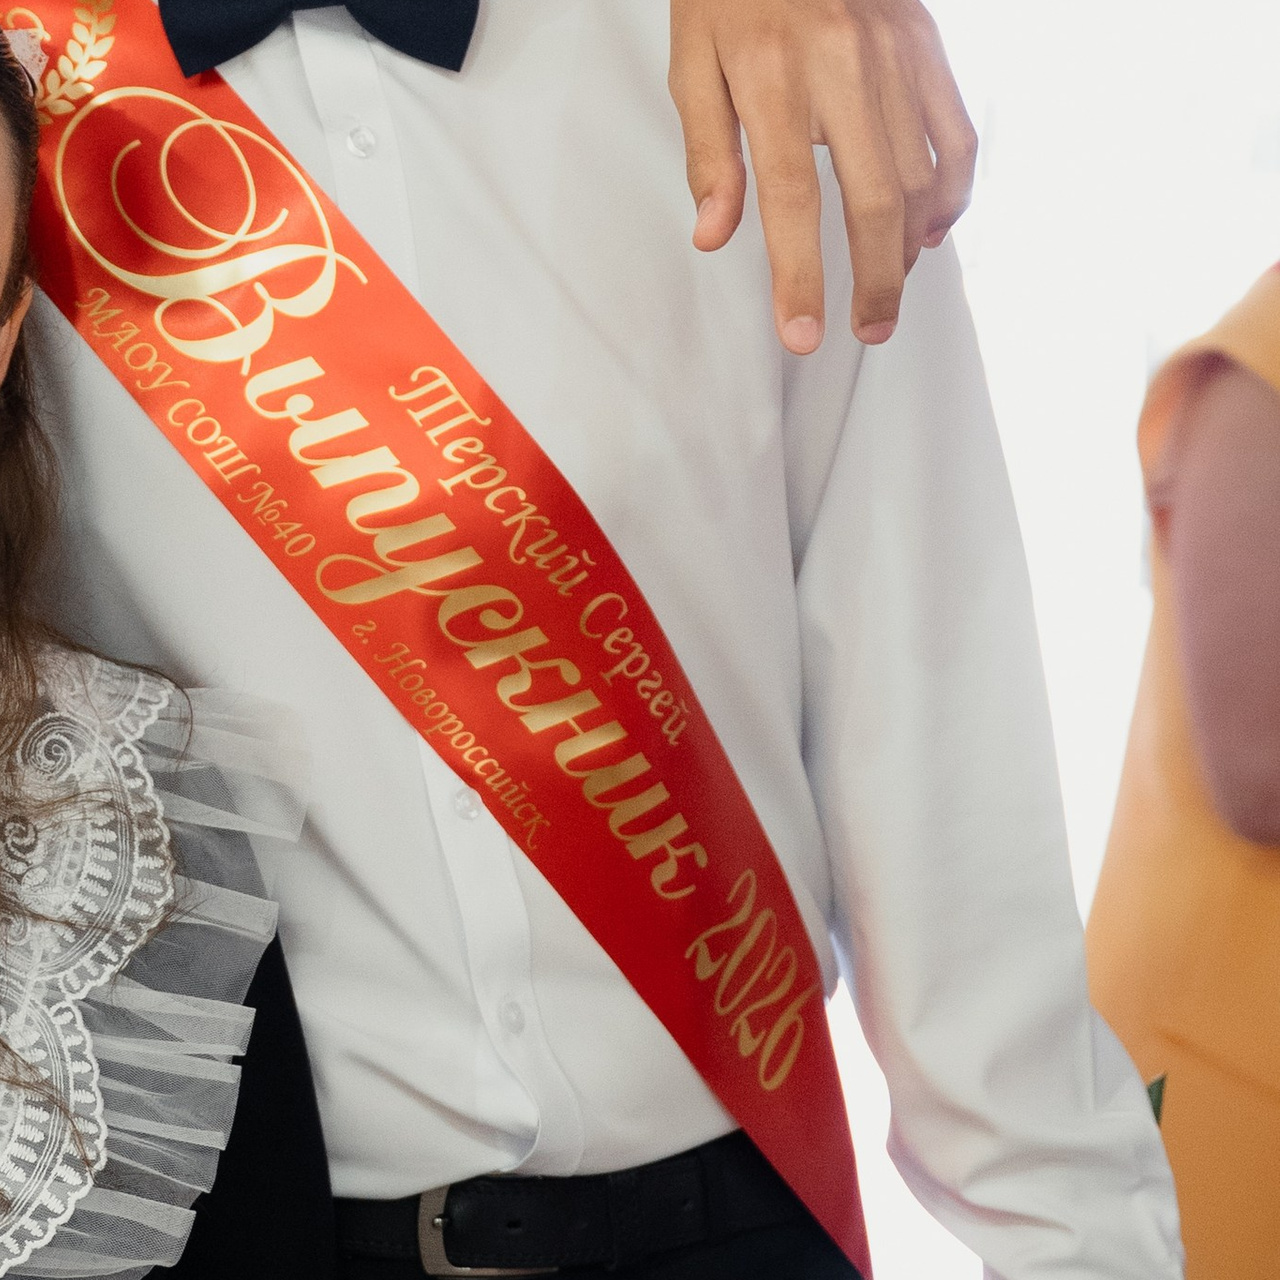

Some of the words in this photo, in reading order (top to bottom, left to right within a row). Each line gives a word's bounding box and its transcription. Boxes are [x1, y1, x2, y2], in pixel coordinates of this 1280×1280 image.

[75, 287, 191, 391] МАОУ
[167, 398, 261, 484] СОШ
[237, 481, 317, 556] №40
[388, 364, 597, 597] Терский
[580, 592, 689, 748] Сергей
[56, 86, 708, 901] Выпускник
[684, 868, 825, 1092] 2026
[373, 642, 552, 850] Новороссийск
